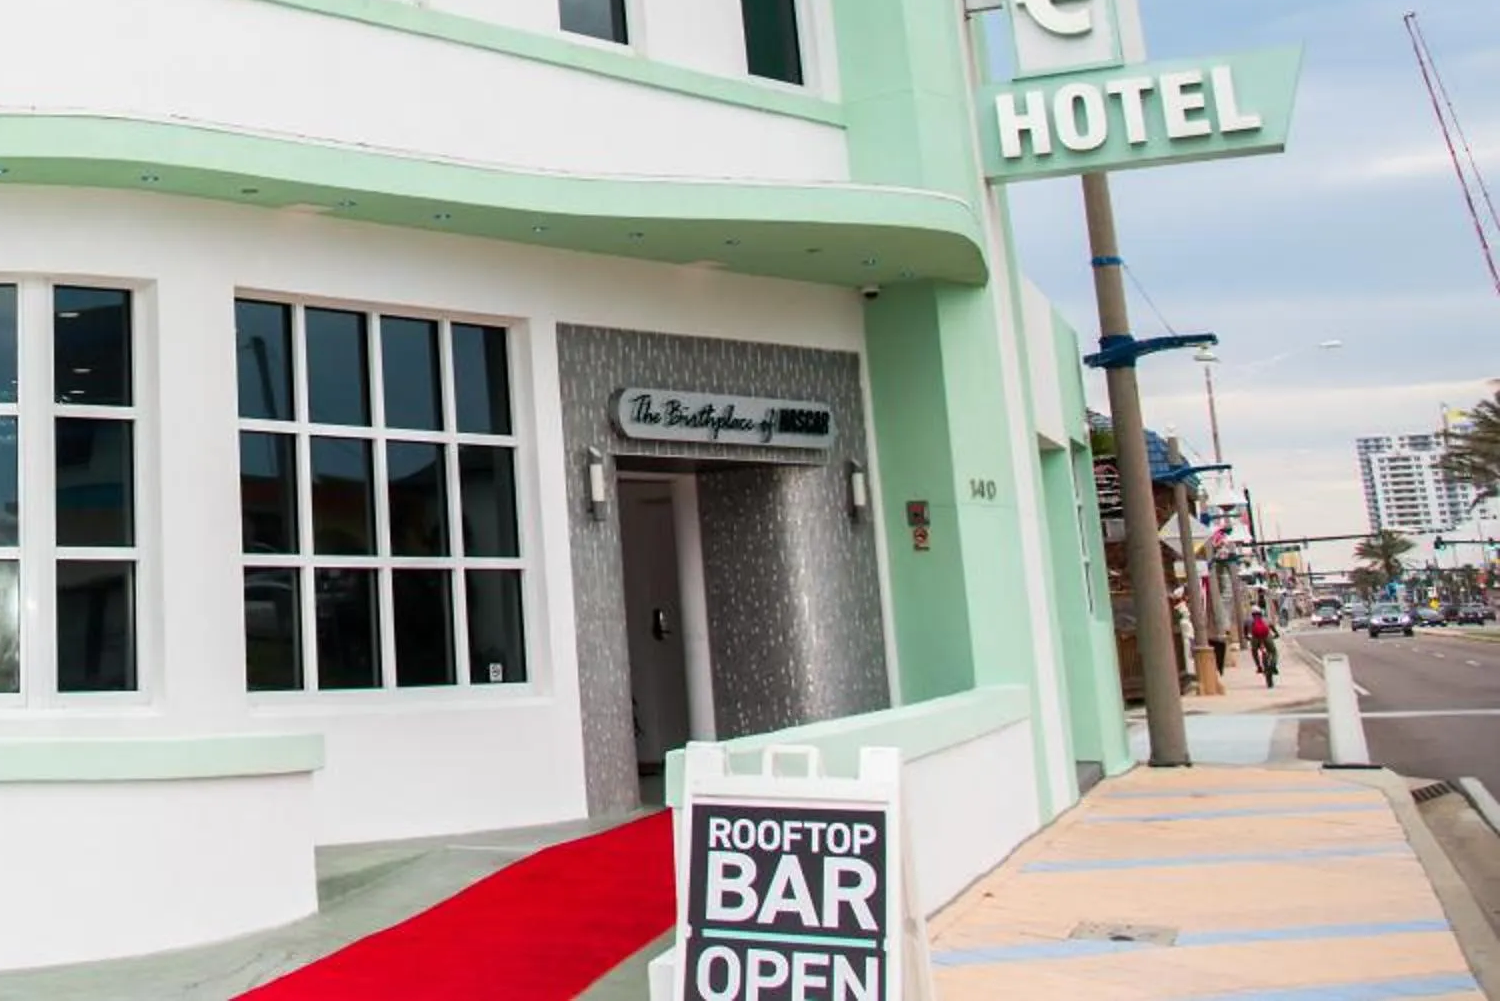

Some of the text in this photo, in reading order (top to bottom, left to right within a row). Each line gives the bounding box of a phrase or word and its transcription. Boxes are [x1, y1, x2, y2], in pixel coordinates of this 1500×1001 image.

[996, 66, 1262, 159] HOTEL
[629, 394, 661, 424] The
[664, 399, 754, 440] Birthplace
[755, 407, 775, 444] of
[969, 478, 997, 501] 140
[709, 817, 877, 854] ROOFTOP
[705, 850, 879, 931] BAR
[696, 946, 879, 1001] OPEN
